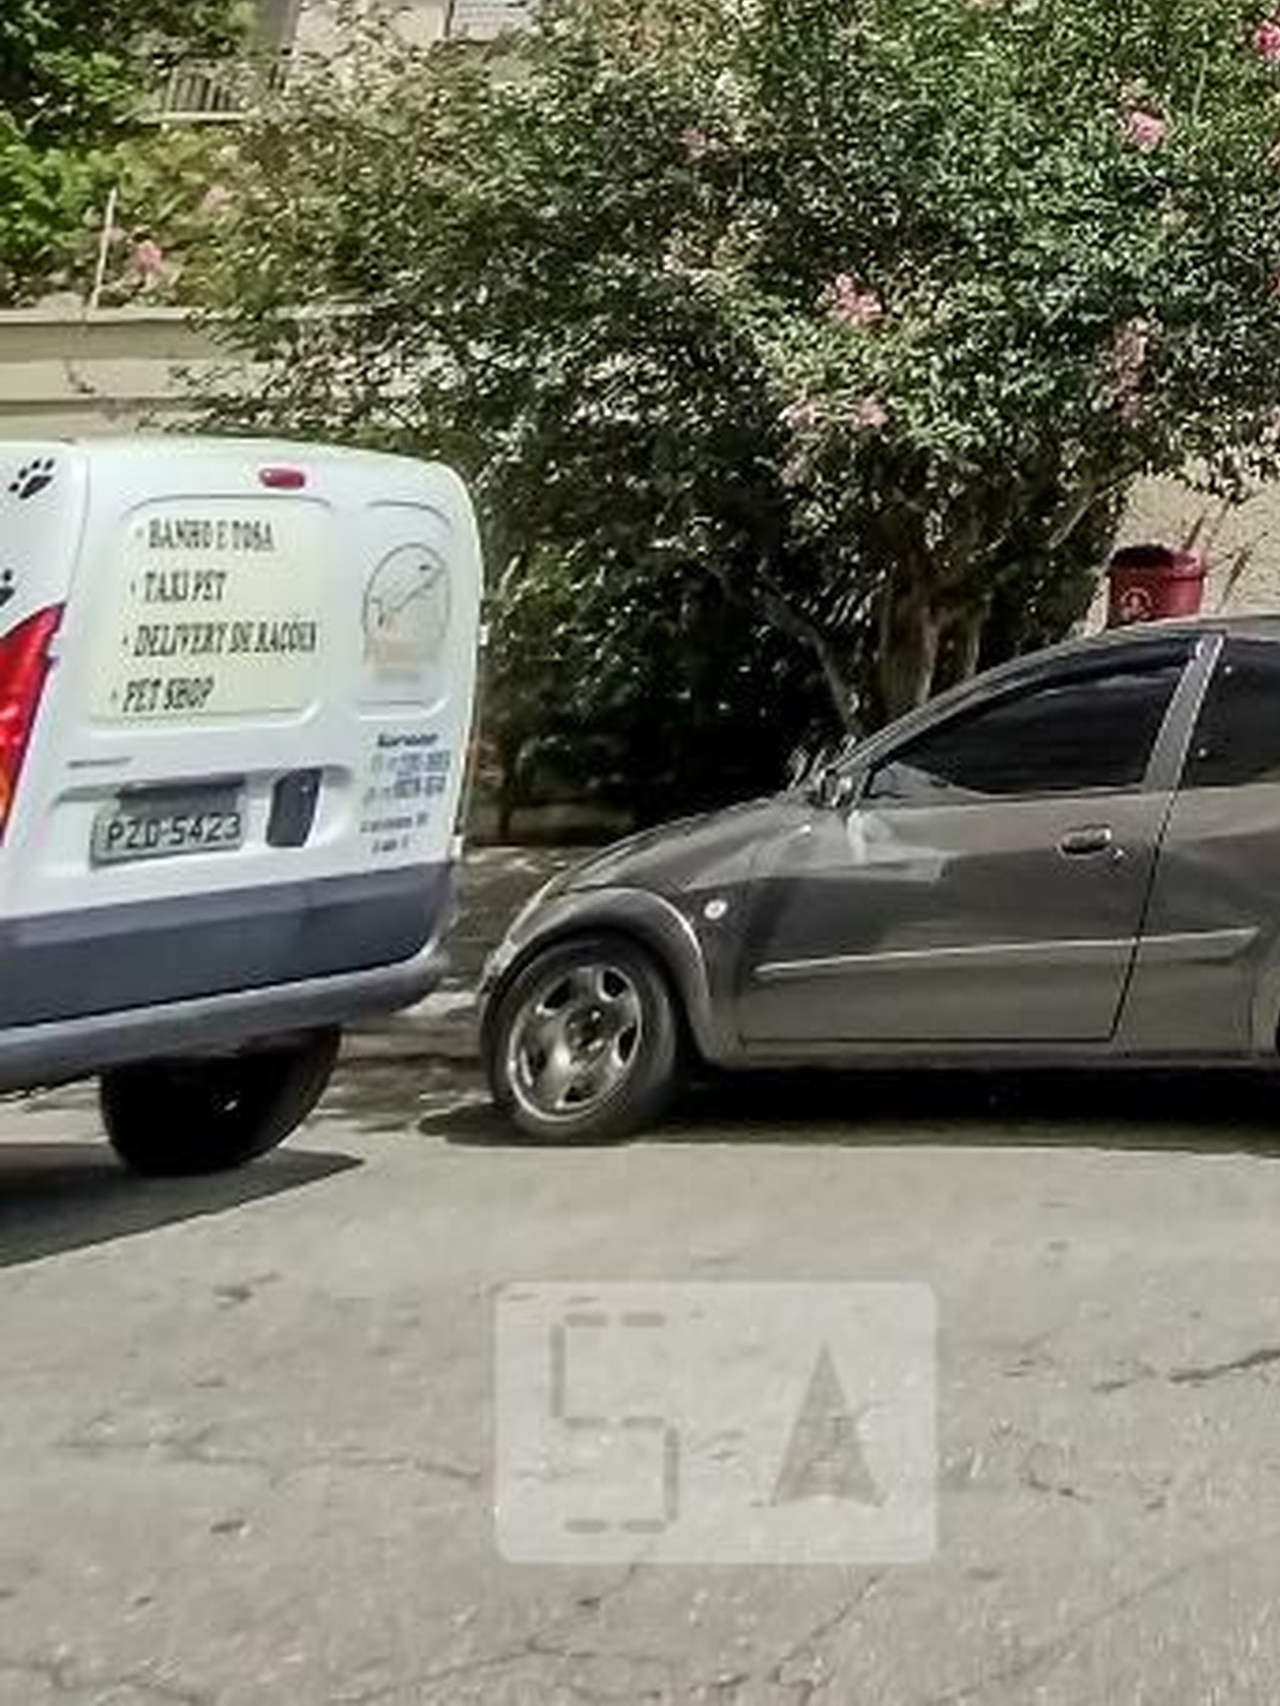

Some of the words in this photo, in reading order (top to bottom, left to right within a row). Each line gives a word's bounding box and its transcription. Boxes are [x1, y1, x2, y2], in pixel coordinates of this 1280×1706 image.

[149, 519, 213, 550] BANHO
[215, 520, 228, 551] E
[231, 520, 275, 553] TOSA
[144, 571, 189, 603] TAXI
[191, 570, 227, 602] PET
[133, 621, 229, 657] DELIVERY
[228, 621, 255, 654] DE
[122, 677, 162, 713] PET
[163, 675, 215, 710] SHOP
